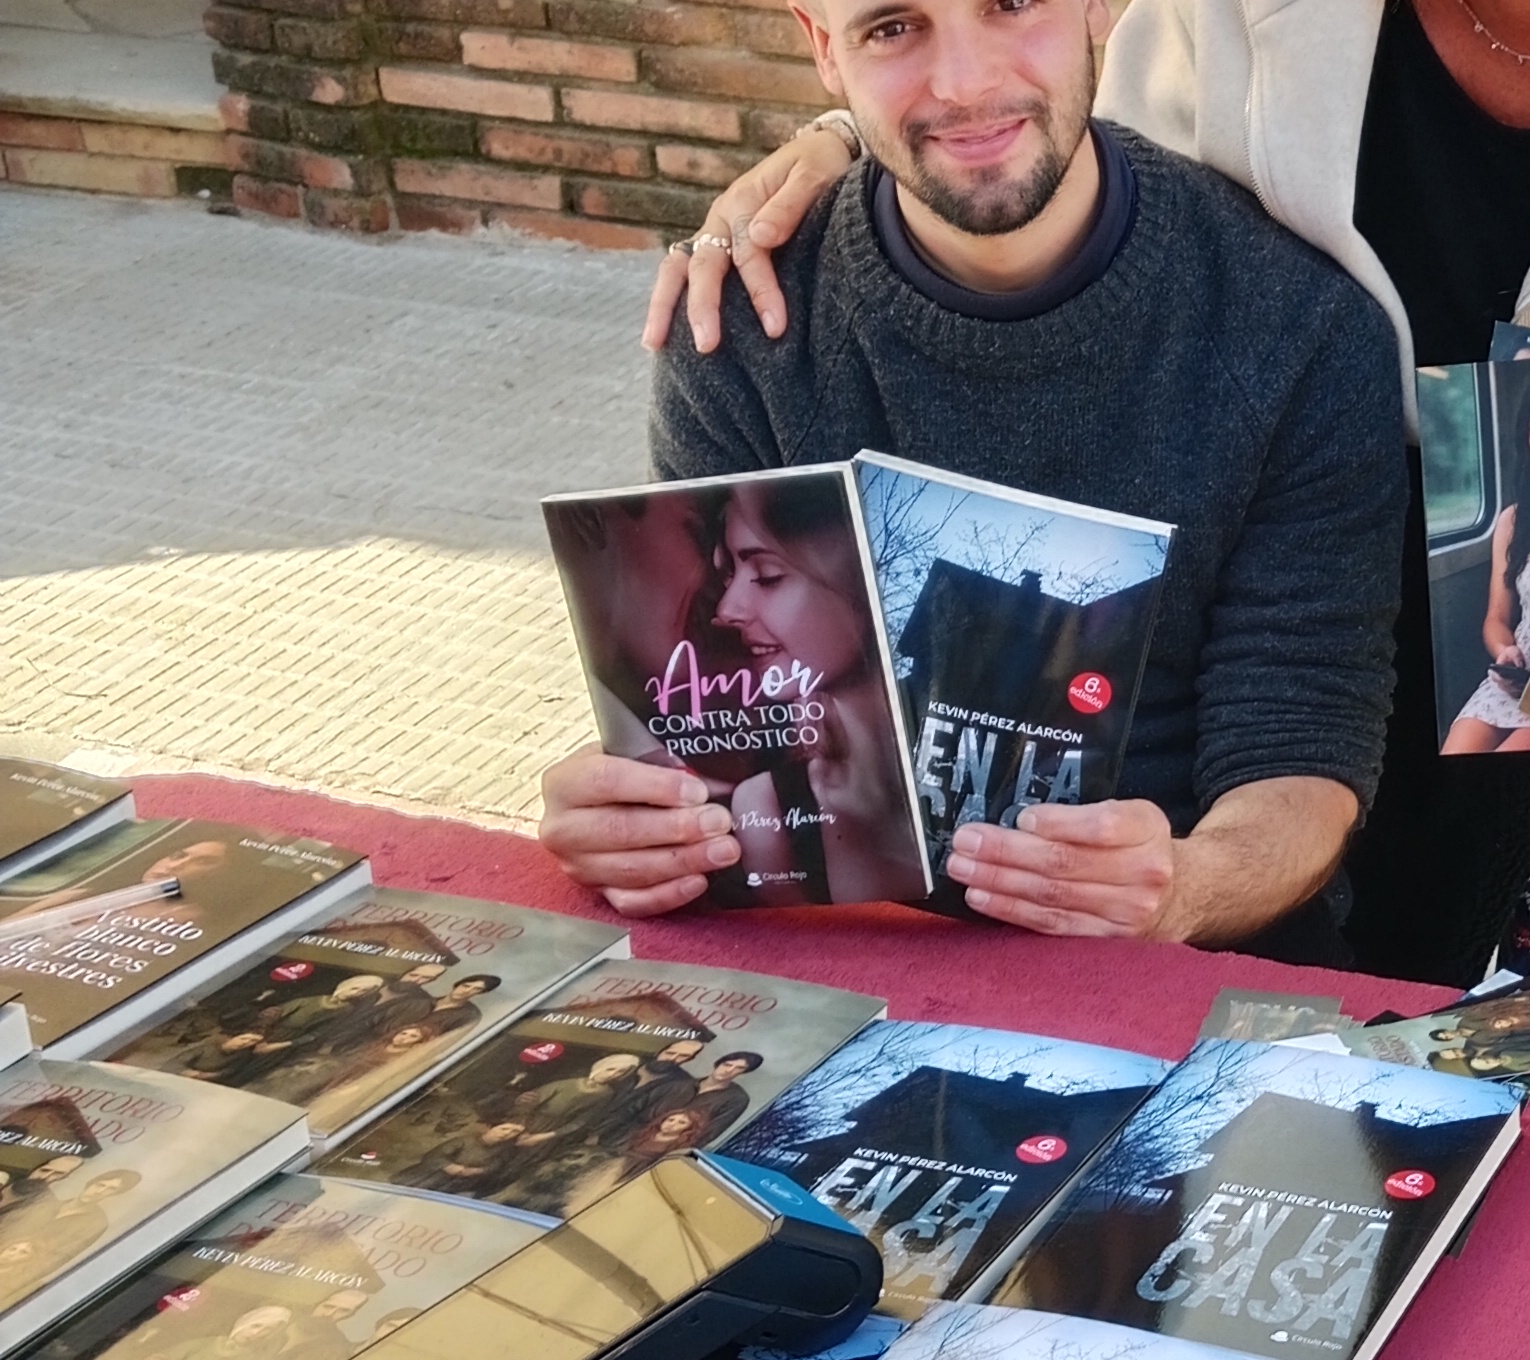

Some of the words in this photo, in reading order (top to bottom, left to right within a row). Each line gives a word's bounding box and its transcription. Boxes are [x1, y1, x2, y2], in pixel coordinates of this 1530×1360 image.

[645, 640, 824, 727] Amor
[648, 708, 752, 737] CONTRA
[754, 701, 825, 725] TODO
[928, 700, 969, 720] KEVIN
[970, 710, 1015, 731] PÉREZ
[1016, 722, 1083, 744] ALARCÓN
[666, 725, 819, 757] PRONÓSTICO
[915, 716, 998, 793] EN
[1014, 741, 1083, 804] LA
[76, 924, 177, 956] blanco
[351, 901, 525, 941] TERRITORIO
[0, 951, 123, 989] ilvestres
[51, 940, 150, 973] flores
[592, 976, 778, 1015] TERRITORIO
[853, 1147, 900, 1163] KEVIN
[896, 1155, 947, 1171] PÉREZ
[944, 1163, 1018, 1183] ALARCÓN
[1219, 1181, 1266, 1199] KEVIN
[1267, 1188, 1319, 1208] PÉREZ
[1317, 1198, 1393, 1220] ALARCÓN
[256, 1197, 464, 1256] TERRITORIO
[1182, 1192, 1294, 1247] EN
[1296, 1212, 1389, 1266] LA
[1136, 1240, 1373, 1340] CASA
